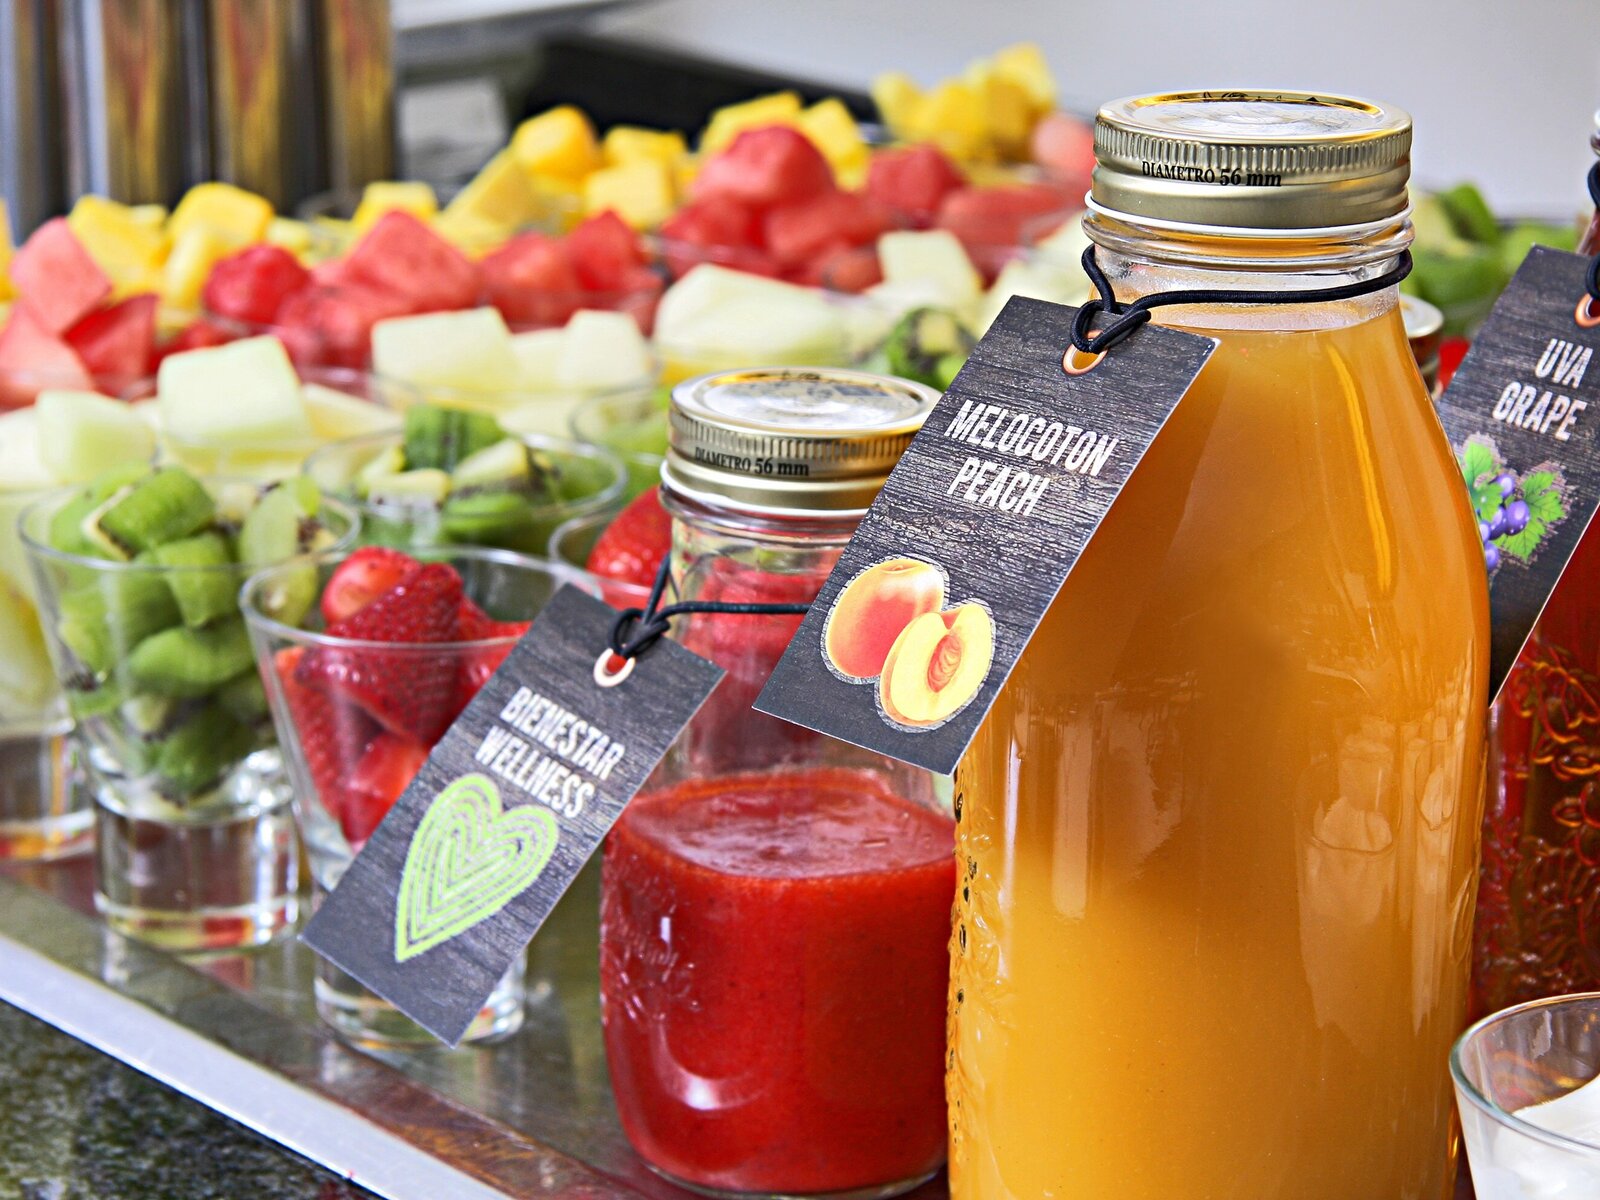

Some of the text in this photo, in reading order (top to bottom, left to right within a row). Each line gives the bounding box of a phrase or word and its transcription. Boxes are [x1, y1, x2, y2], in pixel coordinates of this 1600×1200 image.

[1142, 160, 1282, 187] DIAMETRO 56 mm
[1535, 338, 1593, 388] UVA
[944, 399, 1119, 476] MELOCOTON
[1492, 382, 1588, 441] GRAPE
[695, 447, 810, 476] DIAMETRO 56 mm
[947, 457, 1050, 516] PEACH
[500, 686, 625, 781] BIENESTAR
[475, 725, 595, 818] WELLNESS
